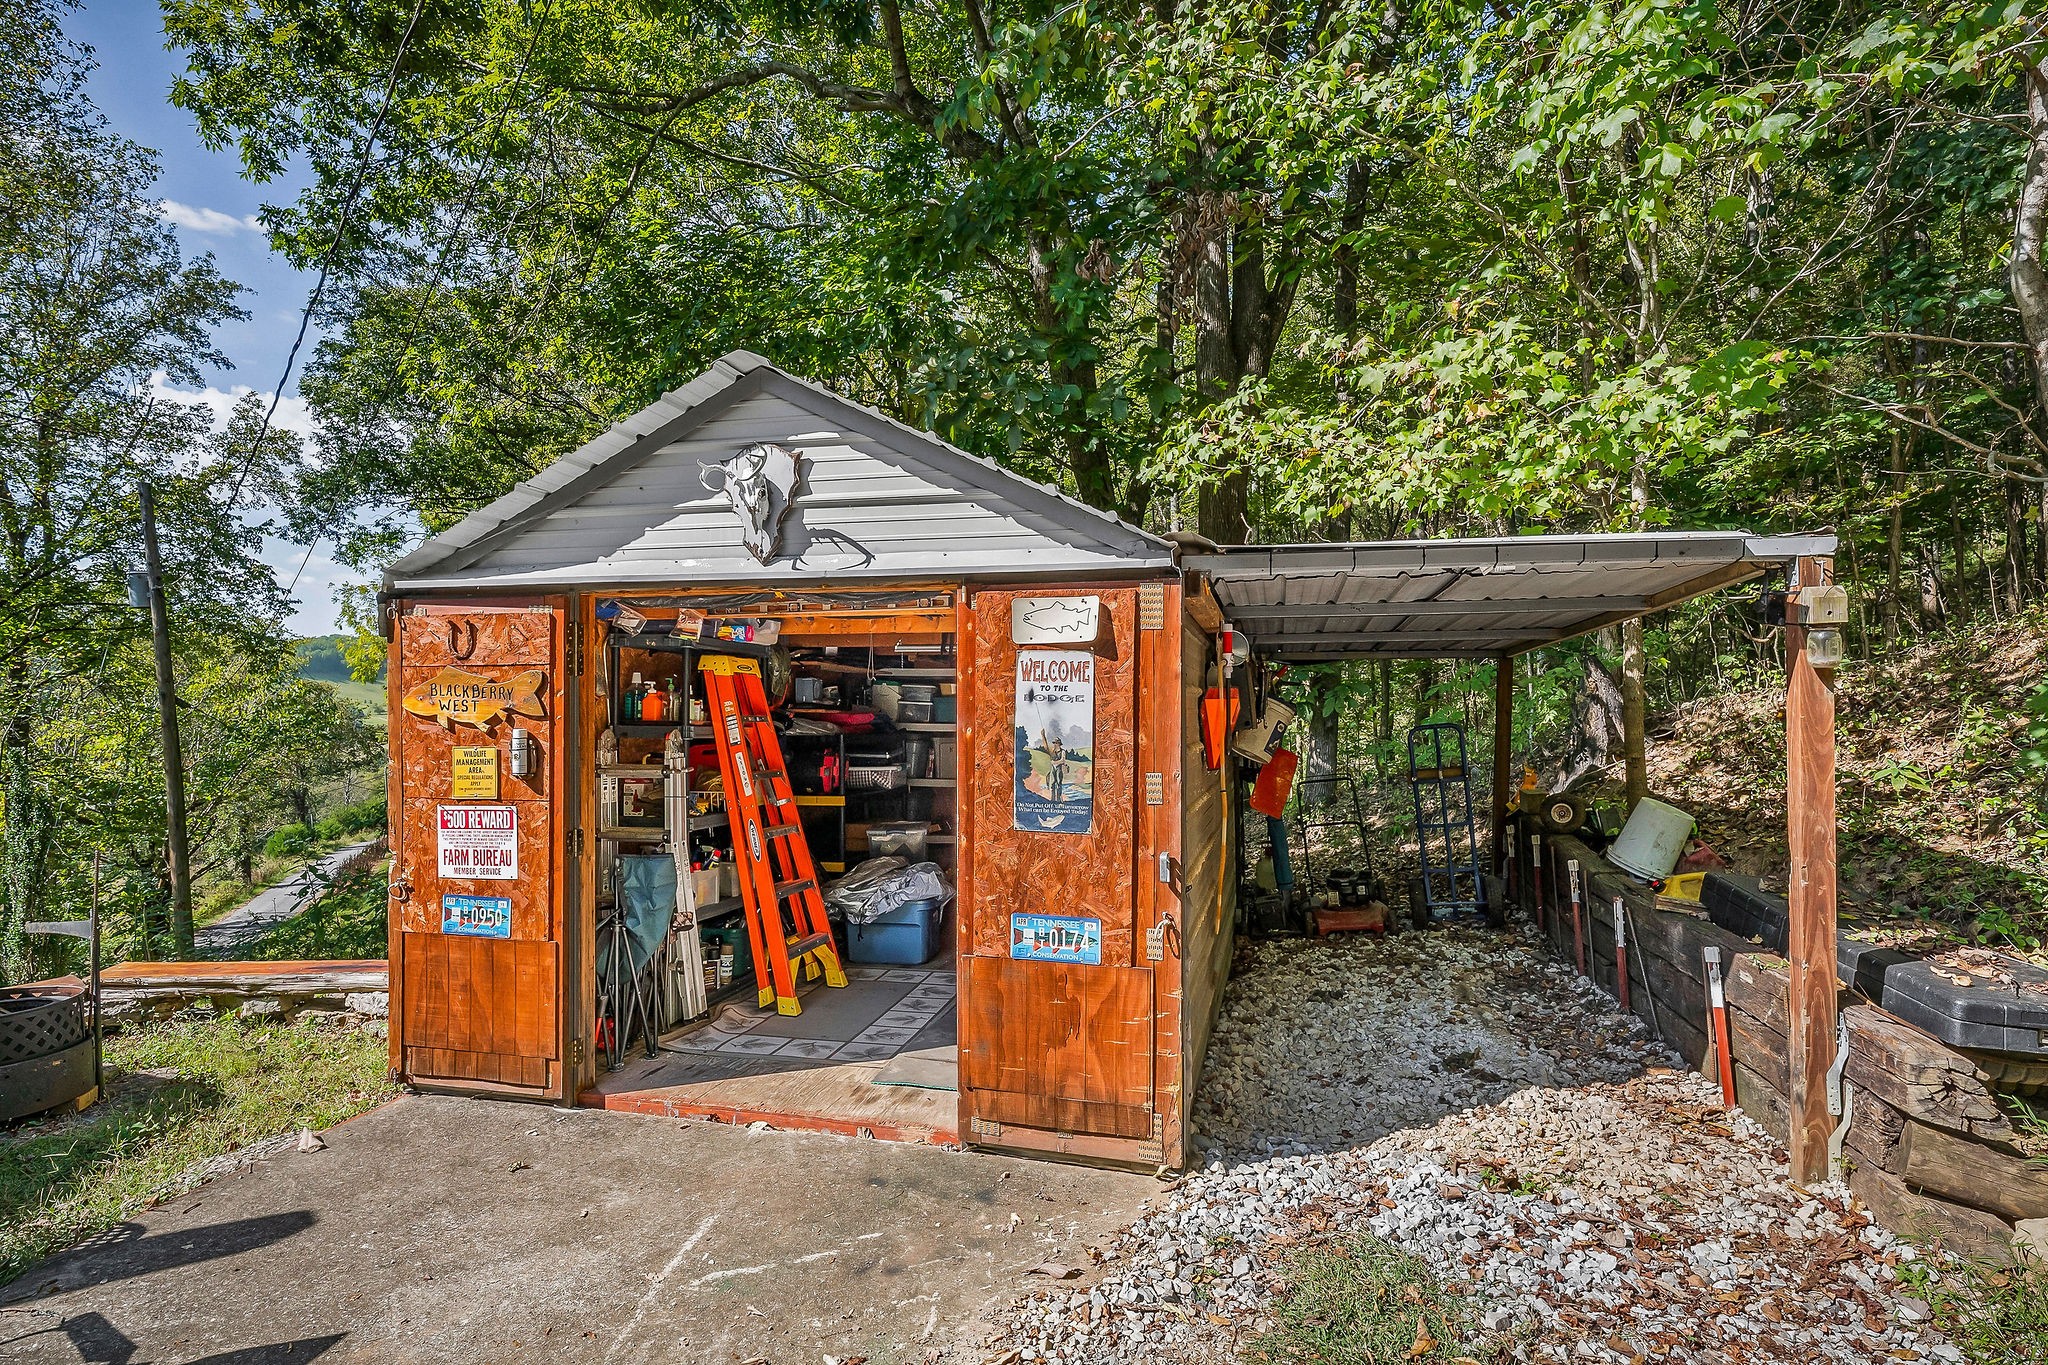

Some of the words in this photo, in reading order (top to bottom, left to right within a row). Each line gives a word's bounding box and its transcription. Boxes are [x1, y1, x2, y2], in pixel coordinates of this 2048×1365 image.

[1020, 658, 1091, 683] WELCOME
[430, 683, 514, 700] BLACKBERRY
[438, 700, 479, 712] WEST
[463, 750, 487, 758] WILDLIFE
[456, 758, 494, 766] MANAGEMENT
[443, 810, 466, 829] $500
[468, 810, 511, 829] REWARD
[443, 849, 469, 866] FARM
[473, 849, 512, 867] BUREAU
[453, 867, 477, 875] MEMBER
[479, 867, 502, 876] SERVICE
[458, 898, 496, 907] TENNESSEE
[471, 907, 502, 926] 0950
[1031, 917, 1080, 929] TENNESSEE
[1032, 952, 1079, 960] CONSERVATION
